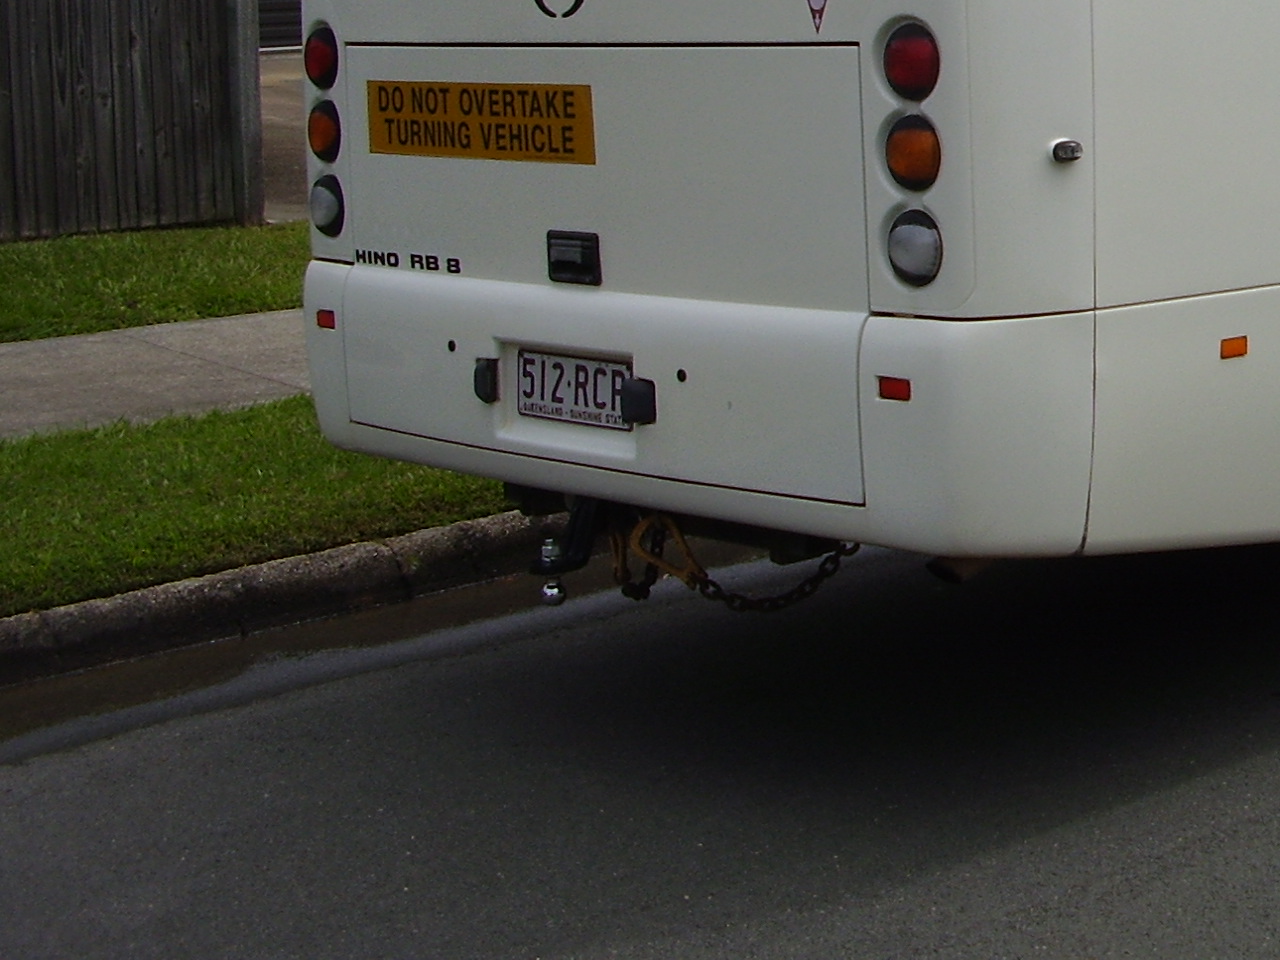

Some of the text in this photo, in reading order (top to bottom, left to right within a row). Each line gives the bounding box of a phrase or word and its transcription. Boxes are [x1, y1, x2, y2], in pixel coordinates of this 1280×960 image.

[378, 86, 576, 119] DO NOT OVERTAKE
[384, 118, 575, 154] TURNING VEHICLE
[355, 249, 461, 274] HINO RB 8
[605, 413, 623, 426] STAT
